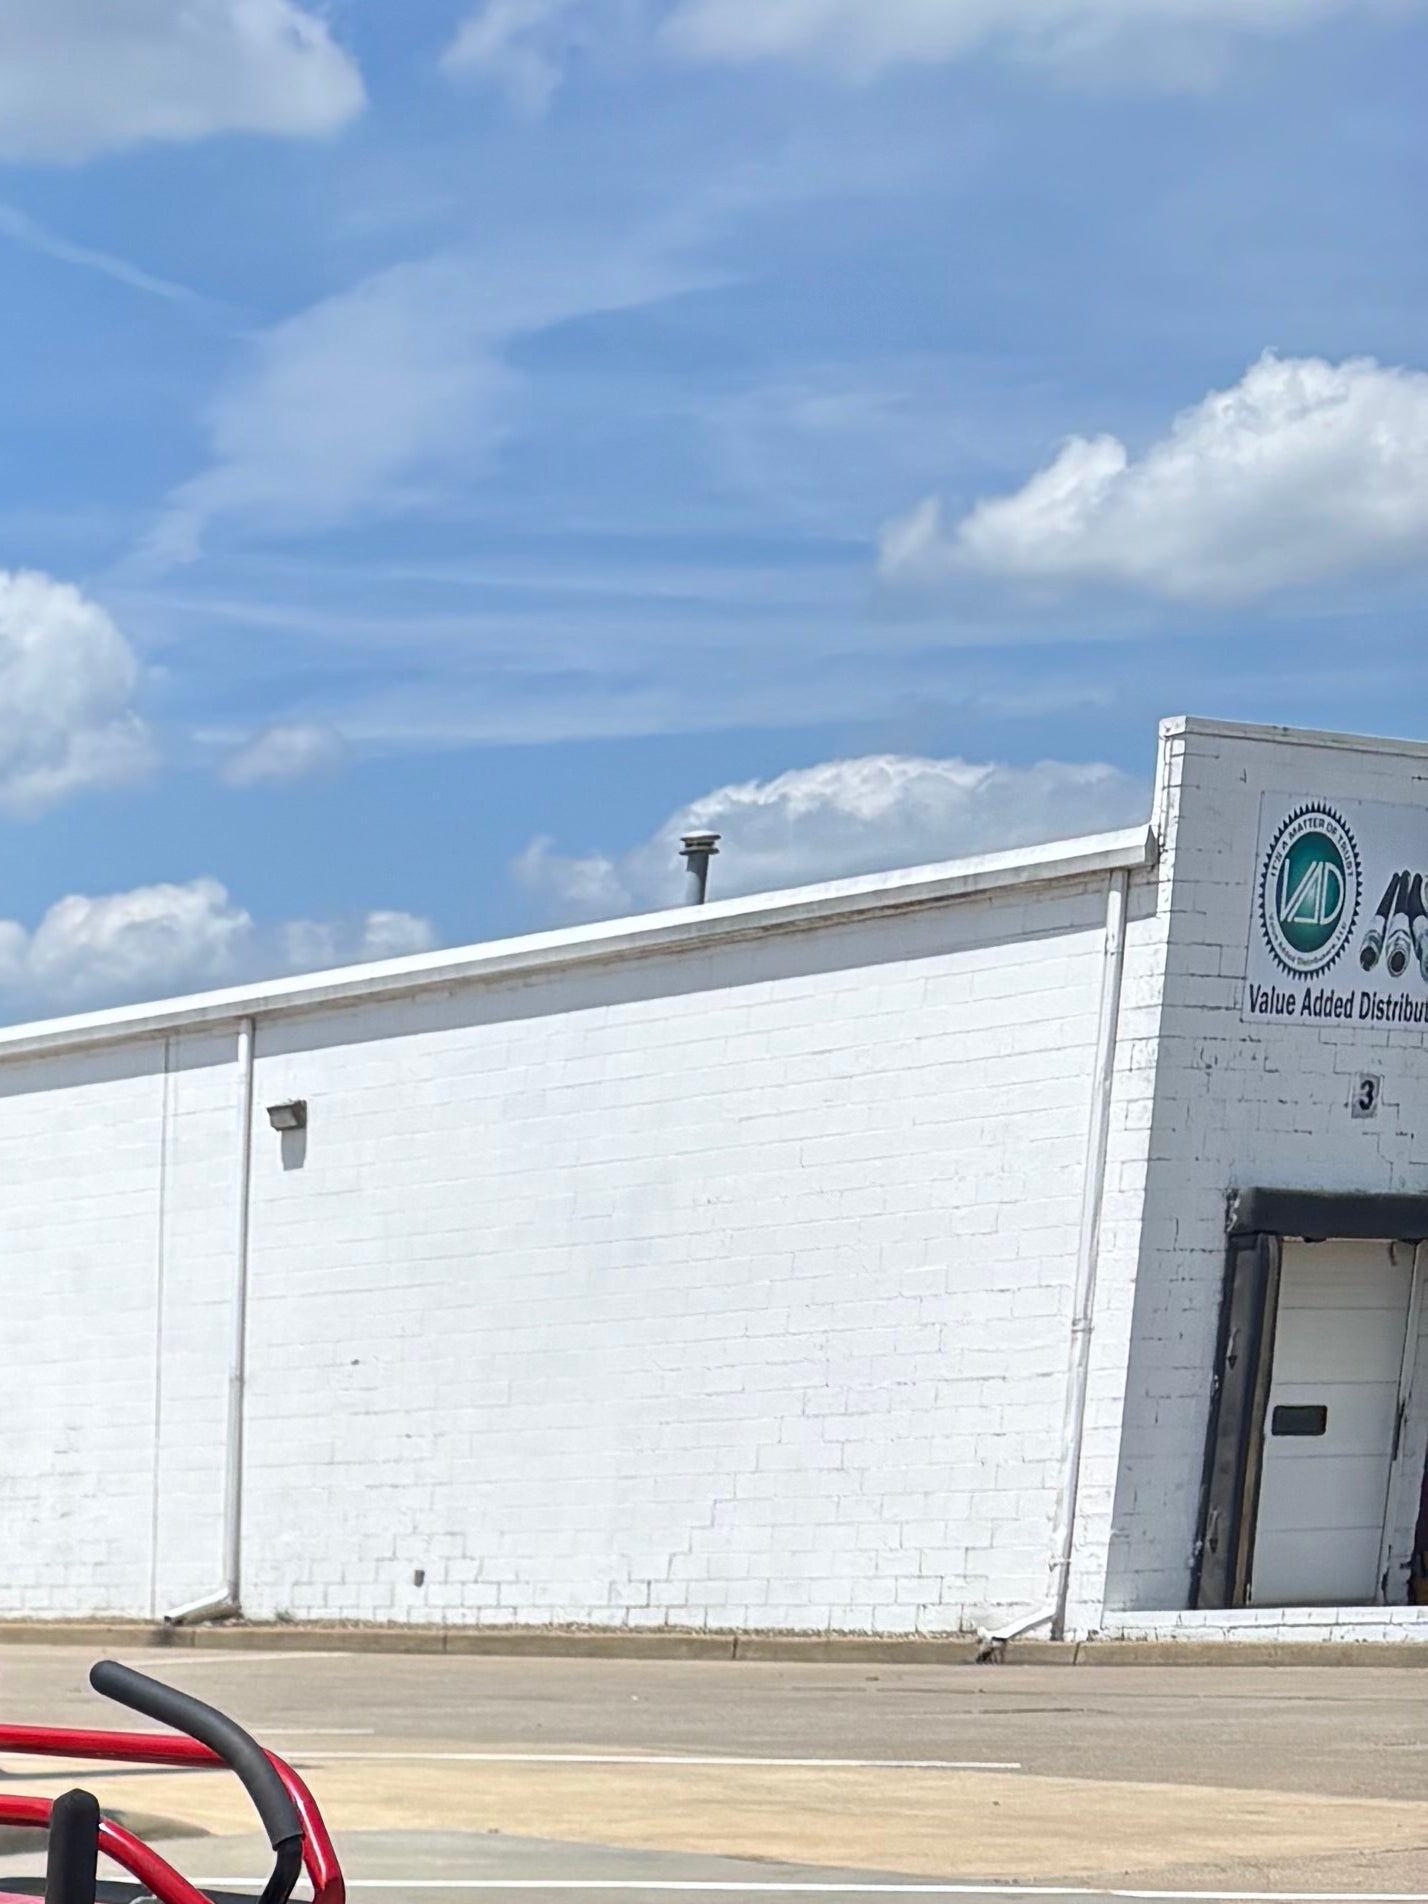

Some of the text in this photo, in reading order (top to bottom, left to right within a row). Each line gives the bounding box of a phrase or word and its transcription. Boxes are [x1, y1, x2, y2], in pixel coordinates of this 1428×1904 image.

[1289, 817, 1326, 839] MATTER
[1326, 822, 1338, 836] OF
[1249, 983, 1296, 1016] Value
[1300, 987, 1356, 1019] Added
[1358, 1079, 1375, 1111] 3
